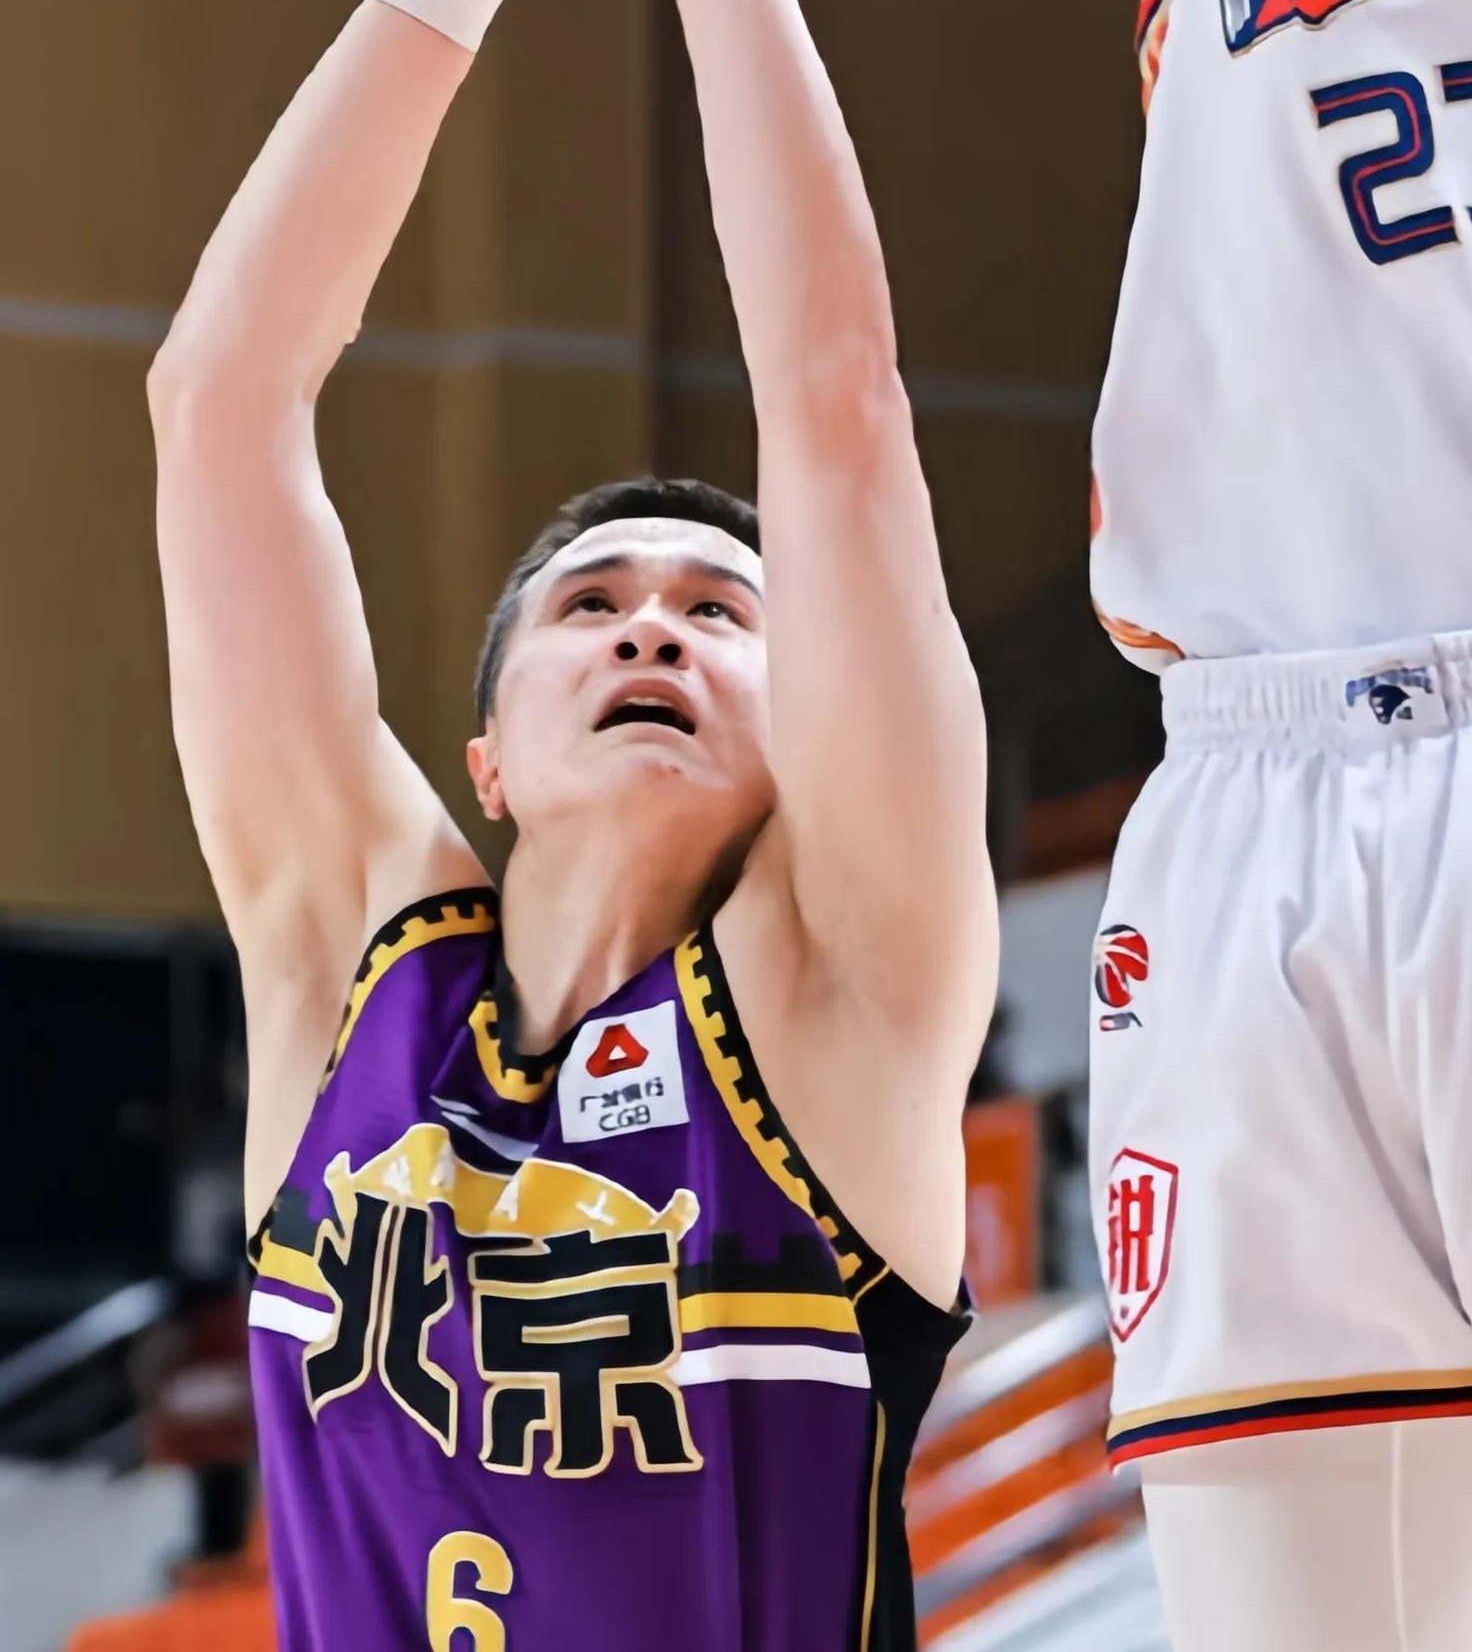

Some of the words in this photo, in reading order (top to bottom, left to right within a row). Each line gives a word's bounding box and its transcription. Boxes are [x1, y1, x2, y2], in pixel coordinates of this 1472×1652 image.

[598, 1104, 651, 1132] CGB
[303, 1186, 704, 1480] 北京
[426, 1530, 514, 1652] 6
